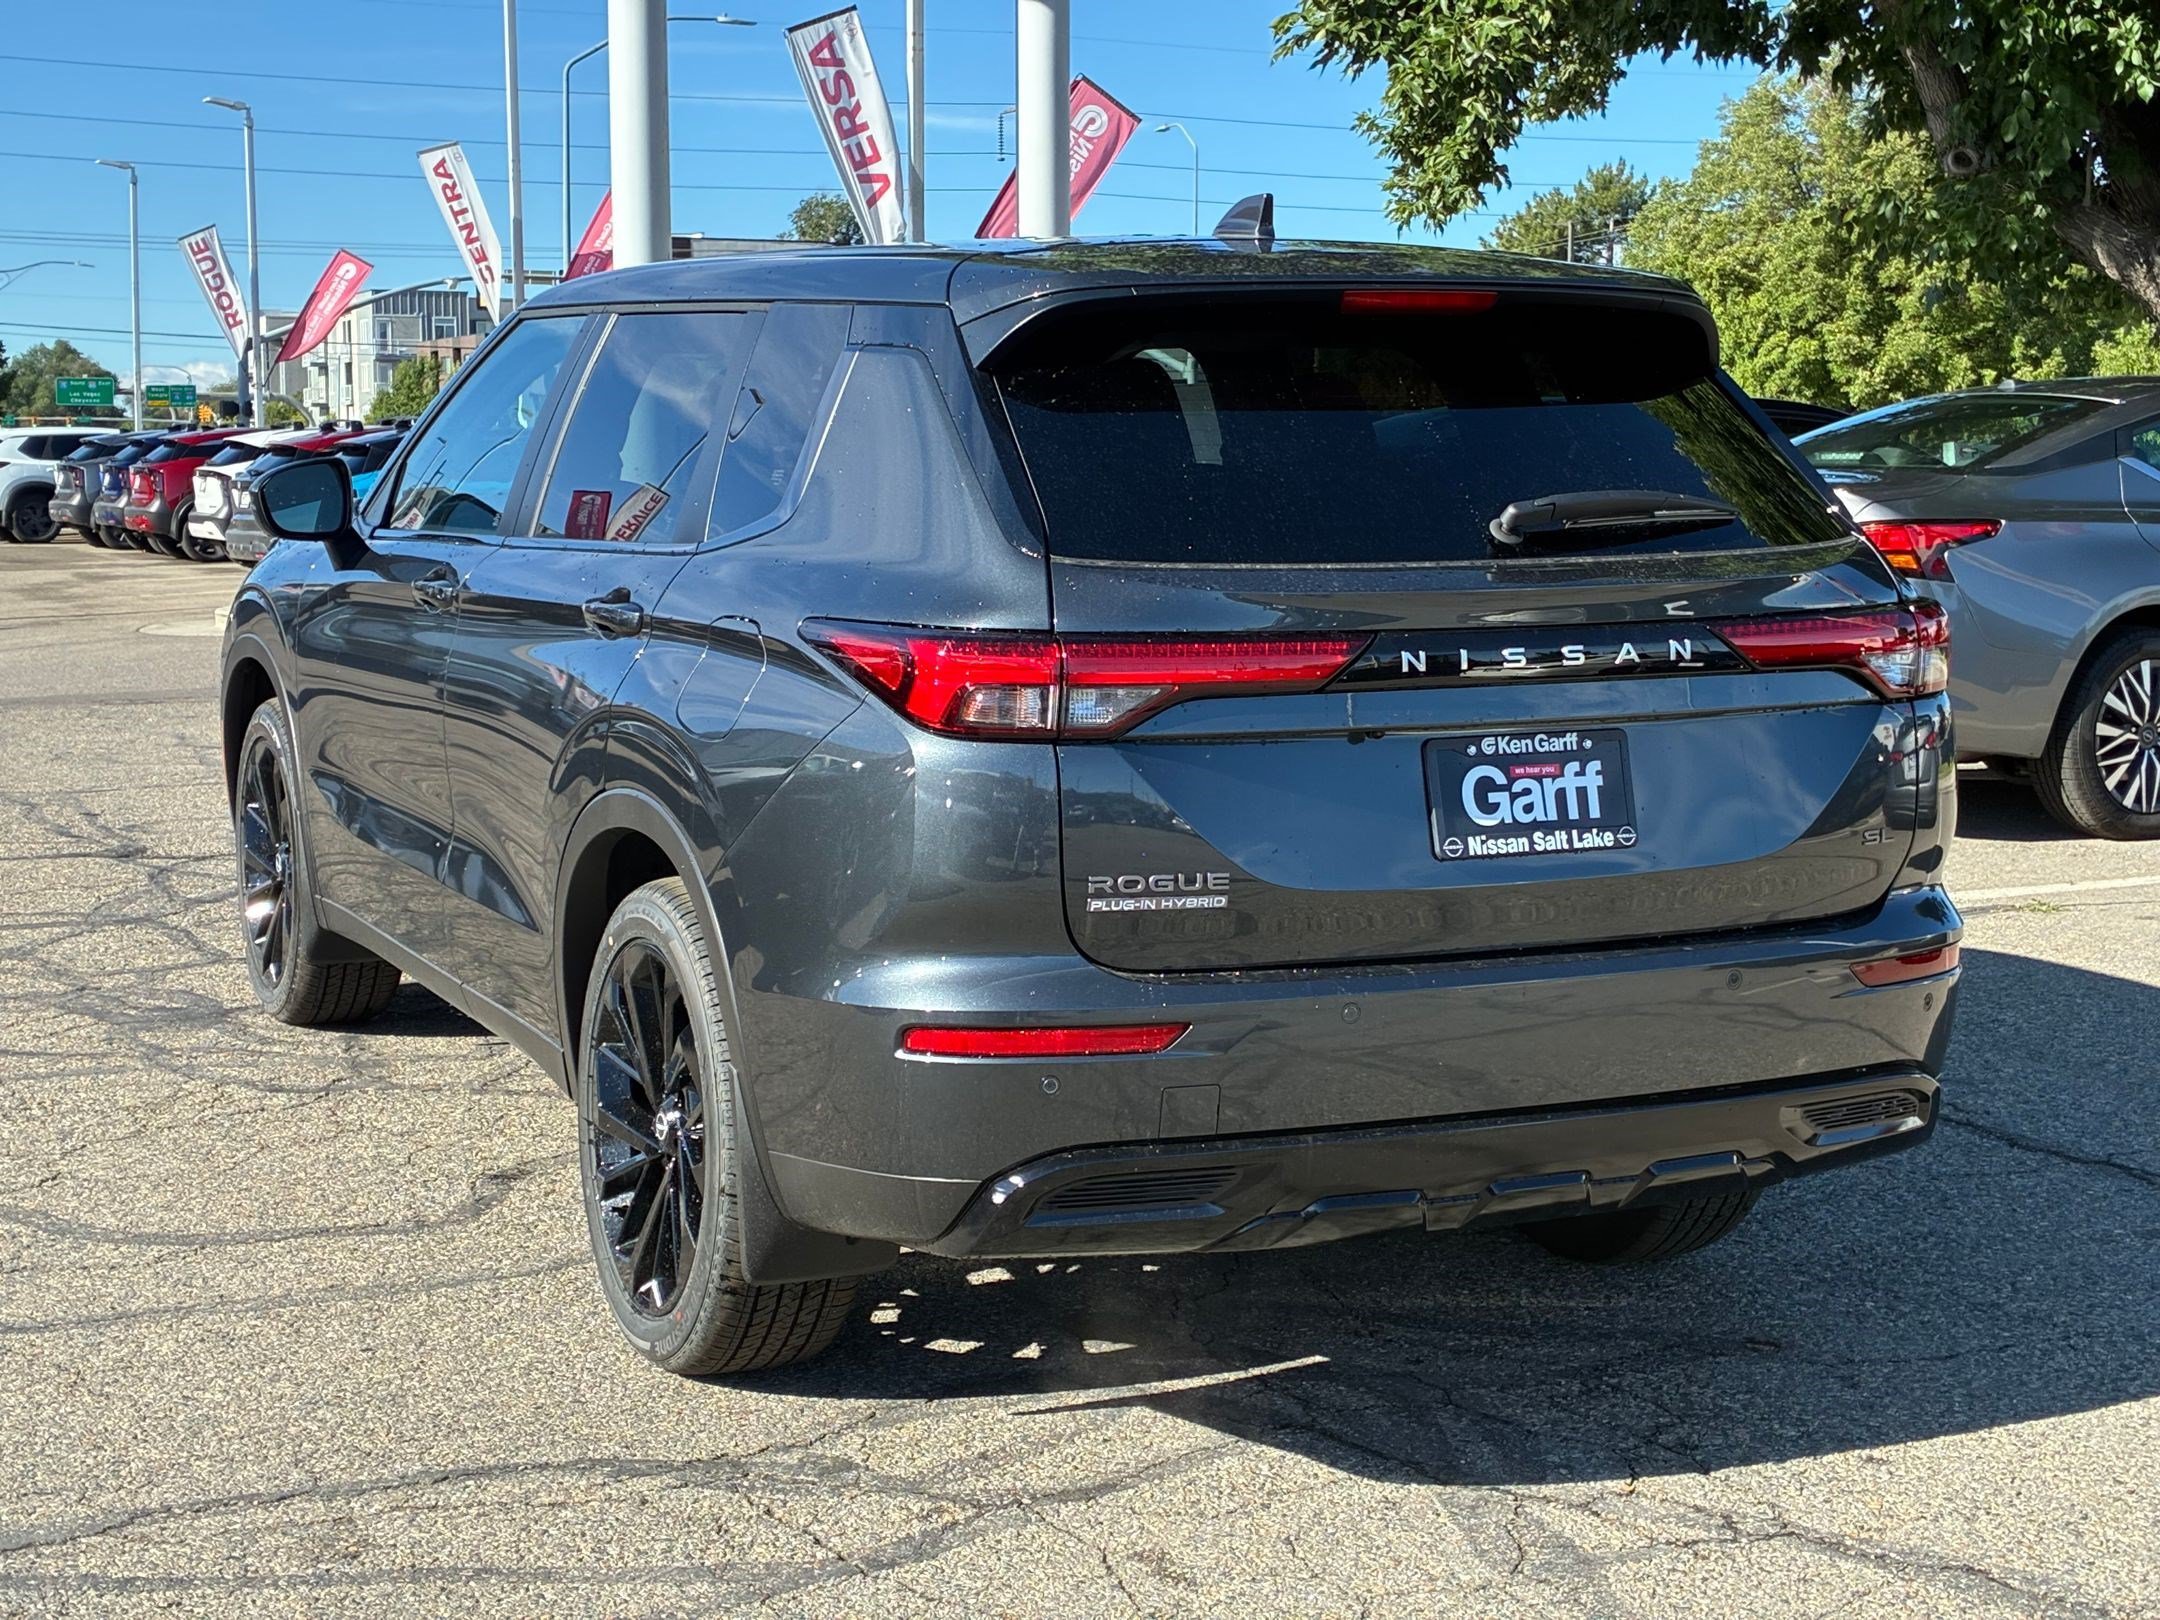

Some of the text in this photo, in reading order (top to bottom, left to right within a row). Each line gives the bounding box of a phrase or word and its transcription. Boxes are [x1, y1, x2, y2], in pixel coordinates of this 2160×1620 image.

[807, 30, 891, 209] VERSA
[432, 156, 496, 284] SENTRA
[188, 236, 244, 330] ROGUE
[1401, 638, 1692, 673] NISSAN
[1497, 735, 1533, 754] Ken
[1534, 732, 1578, 752] Garff
[1526, 765, 1541, 774] hear
[1542, 765, 1555, 774] you
[1462, 760, 1604, 827] Garff
[1467, 828, 1614, 856] Nissan Salt Lake
[1863, 829, 1894, 845] SL
[1088, 872, 1231, 894] ROGUE
[1089, 896, 1226, 912] PLUG-IN HYBRID
